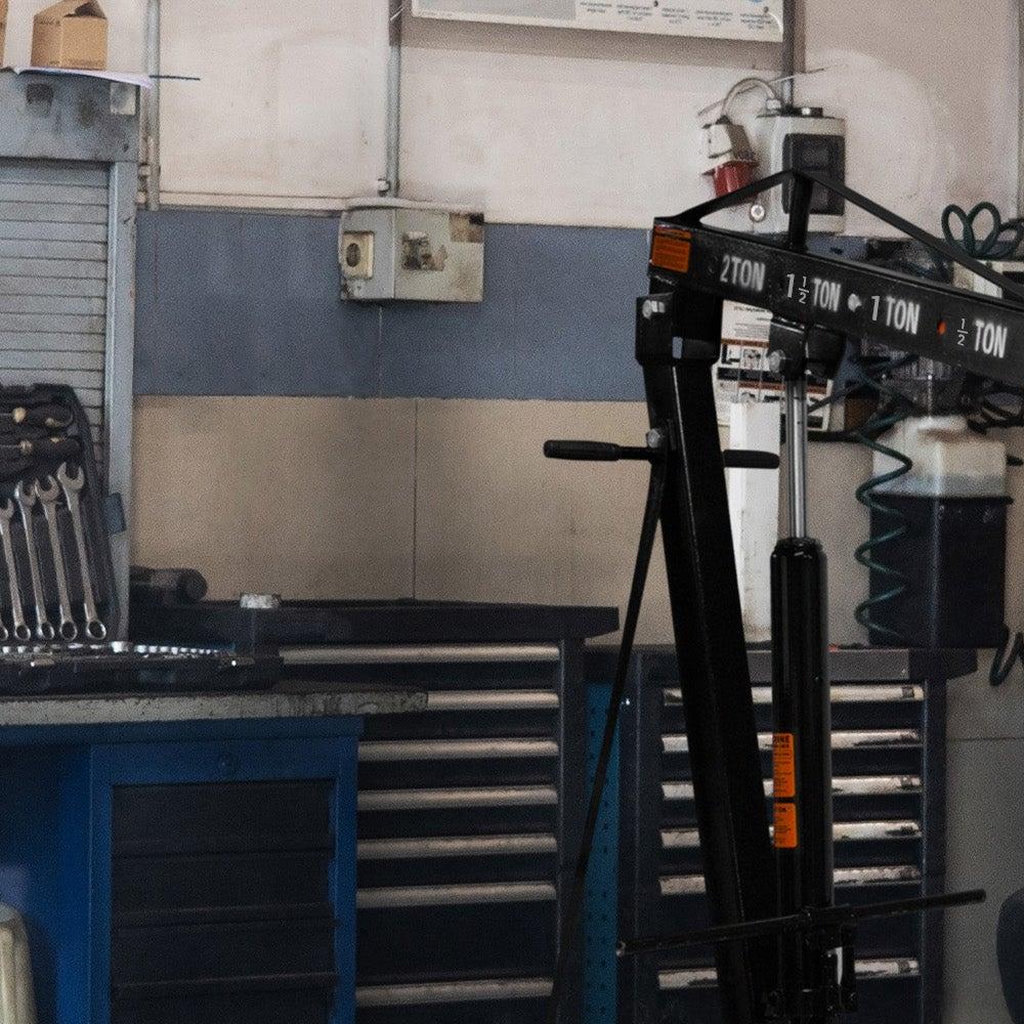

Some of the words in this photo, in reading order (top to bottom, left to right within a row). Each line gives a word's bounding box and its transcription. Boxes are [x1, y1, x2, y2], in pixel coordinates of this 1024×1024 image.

[813, 277, 842, 312] TON
[871, 295, 881, 321] 1
[885, 295, 921, 335] TON
[974, 319, 1008, 359] TON
